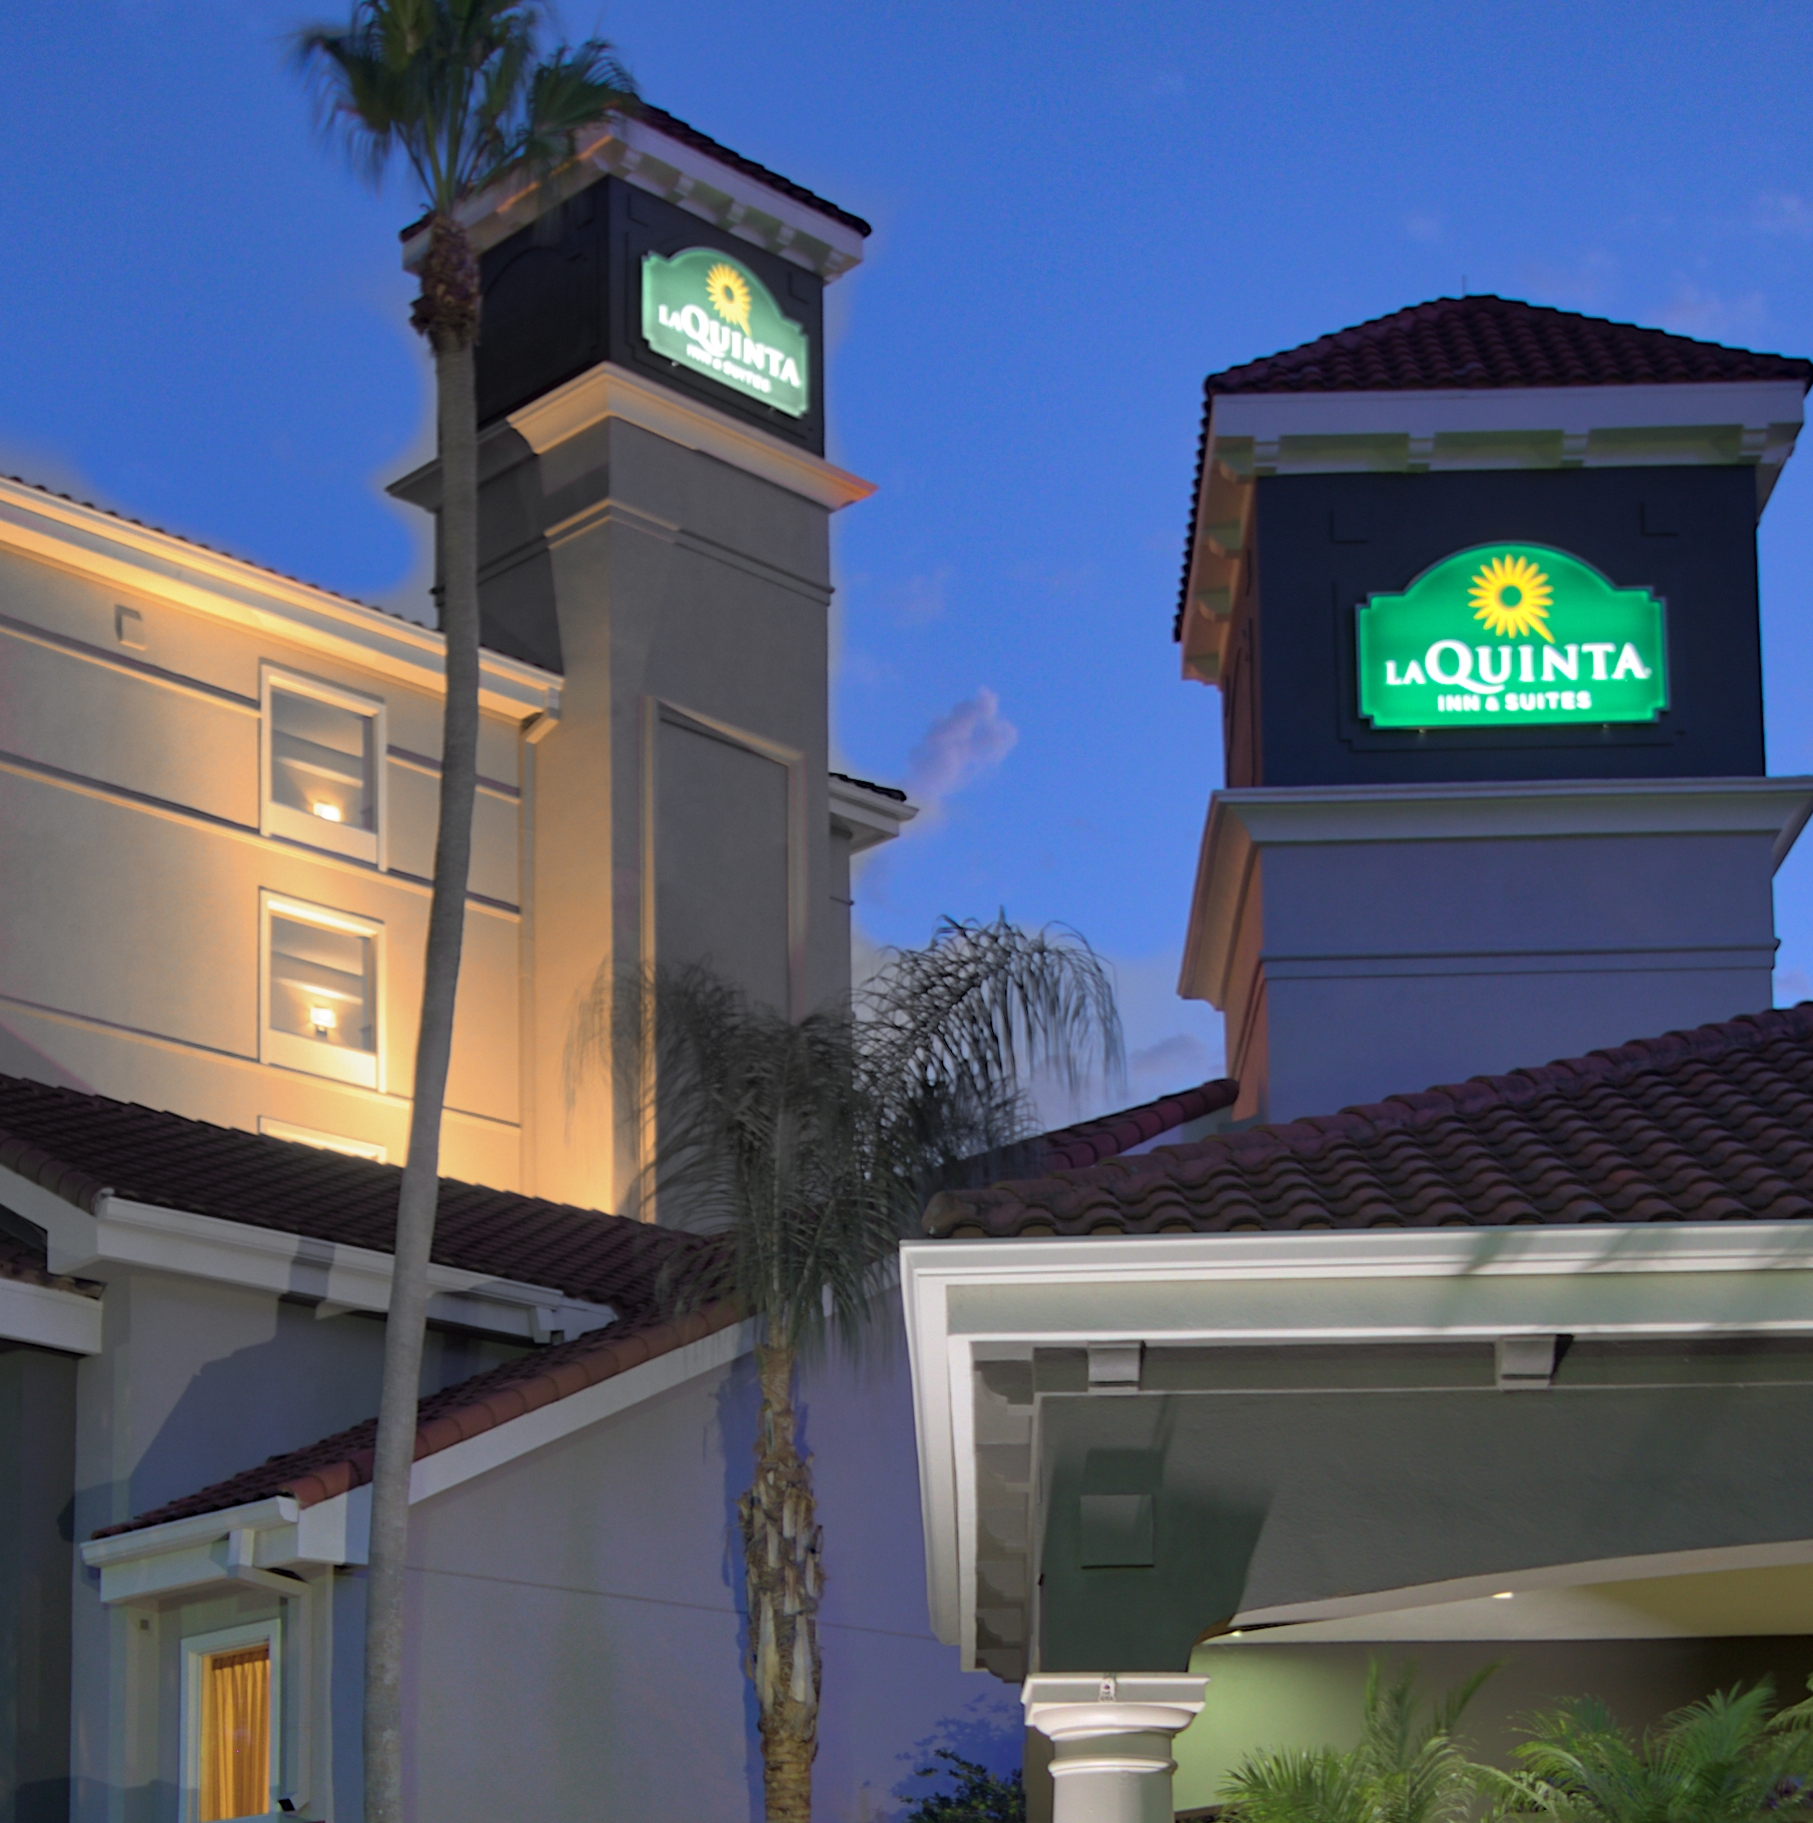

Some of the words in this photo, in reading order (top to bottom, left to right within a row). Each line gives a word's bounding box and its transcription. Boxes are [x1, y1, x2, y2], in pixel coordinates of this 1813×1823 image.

[680, 304, 801, 388] QUINTA
[1425, 639, 1653, 694] QUINTA
[1437, 694, 1480, 712] INN
[1504, 690, 1592, 711] SUITES
